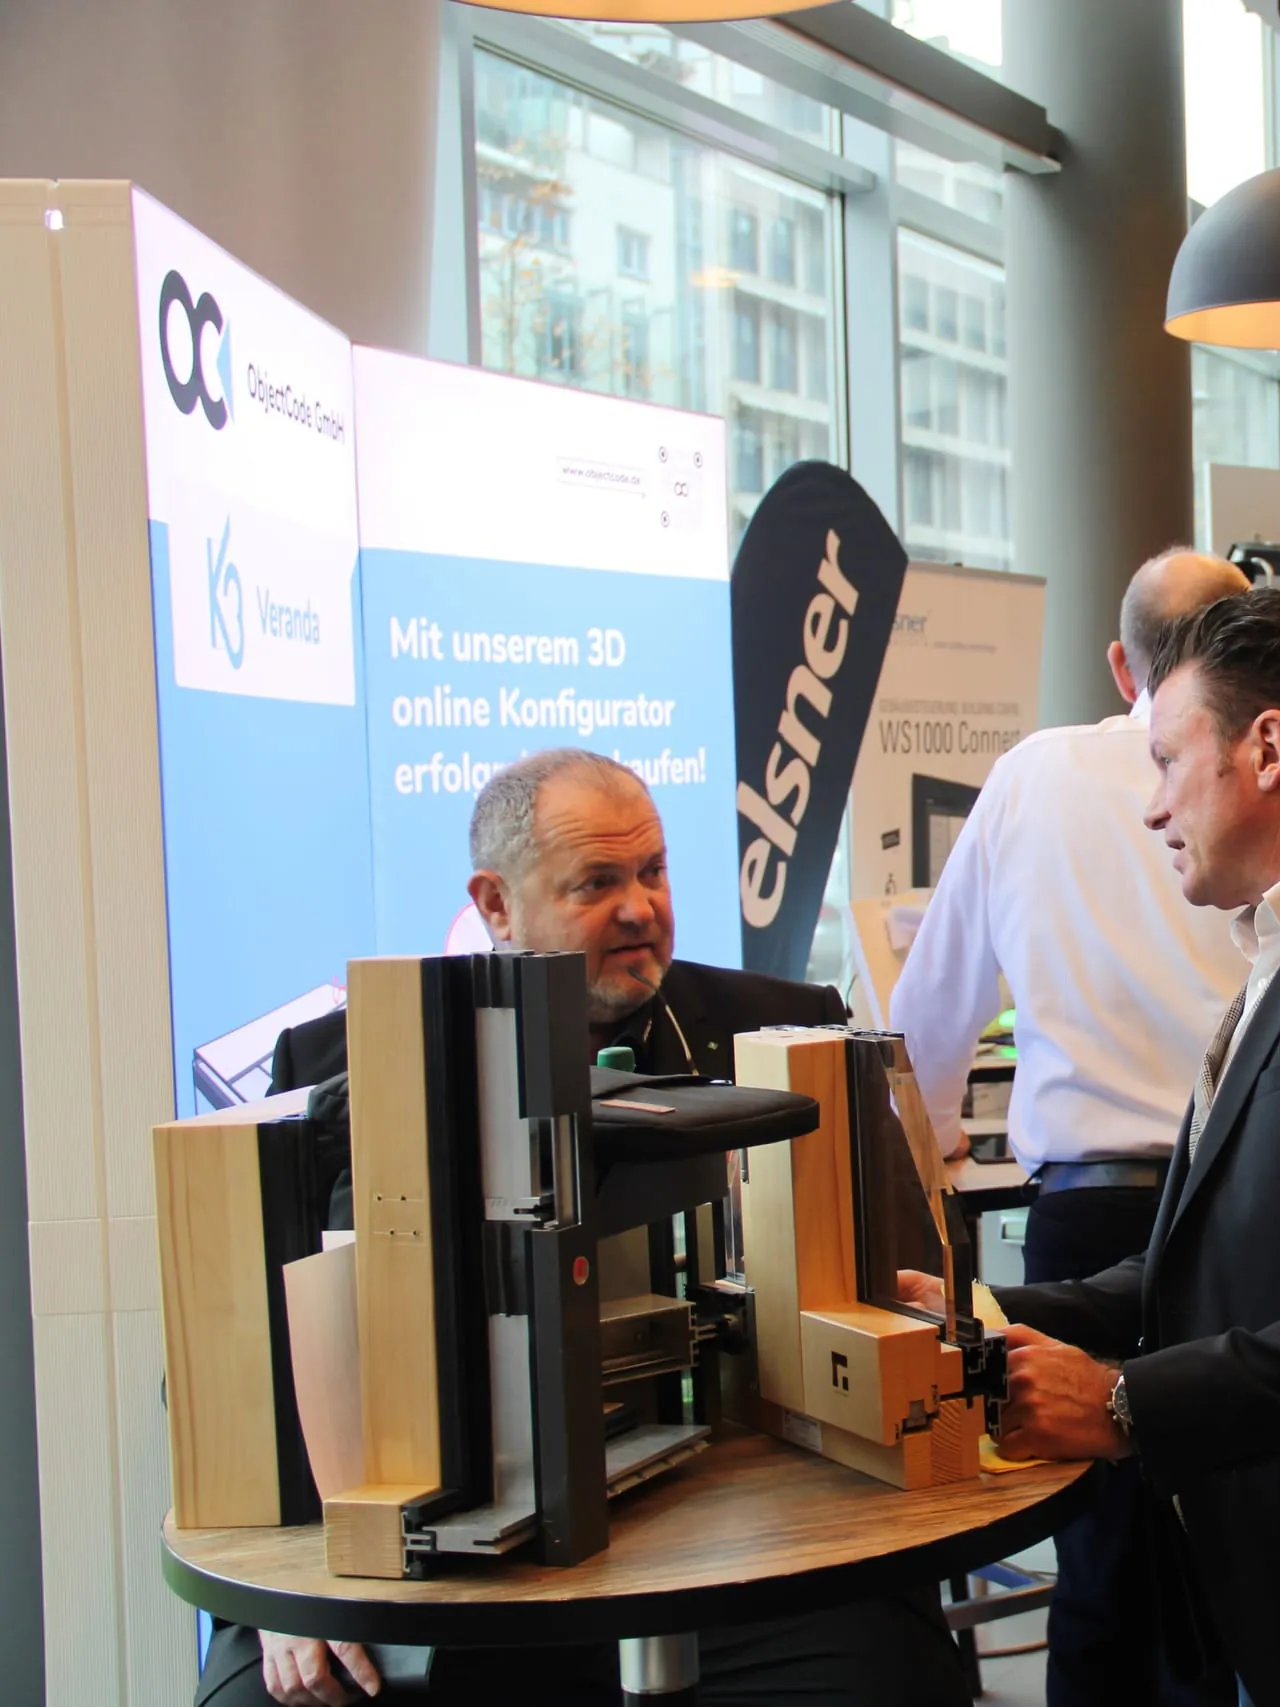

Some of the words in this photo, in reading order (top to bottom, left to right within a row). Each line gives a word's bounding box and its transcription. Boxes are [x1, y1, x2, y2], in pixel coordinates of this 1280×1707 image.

[247, 363, 312, 428] ObjectCode
[314, 402, 345, 444] GmbH
[256, 585, 320, 645] Veranda
[893, 613, 927, 632] sner
[390, 616, 444, 660] Mit
[453, 631, 579, 666] unserem
[587, 627, 626, 667] 3D
[392, 684, 490, 728] online
[499, 686, 676, 736] Konfigurator
[736, 528, 860, 929] elsner
[879, 719, 953, 754] WS1000
